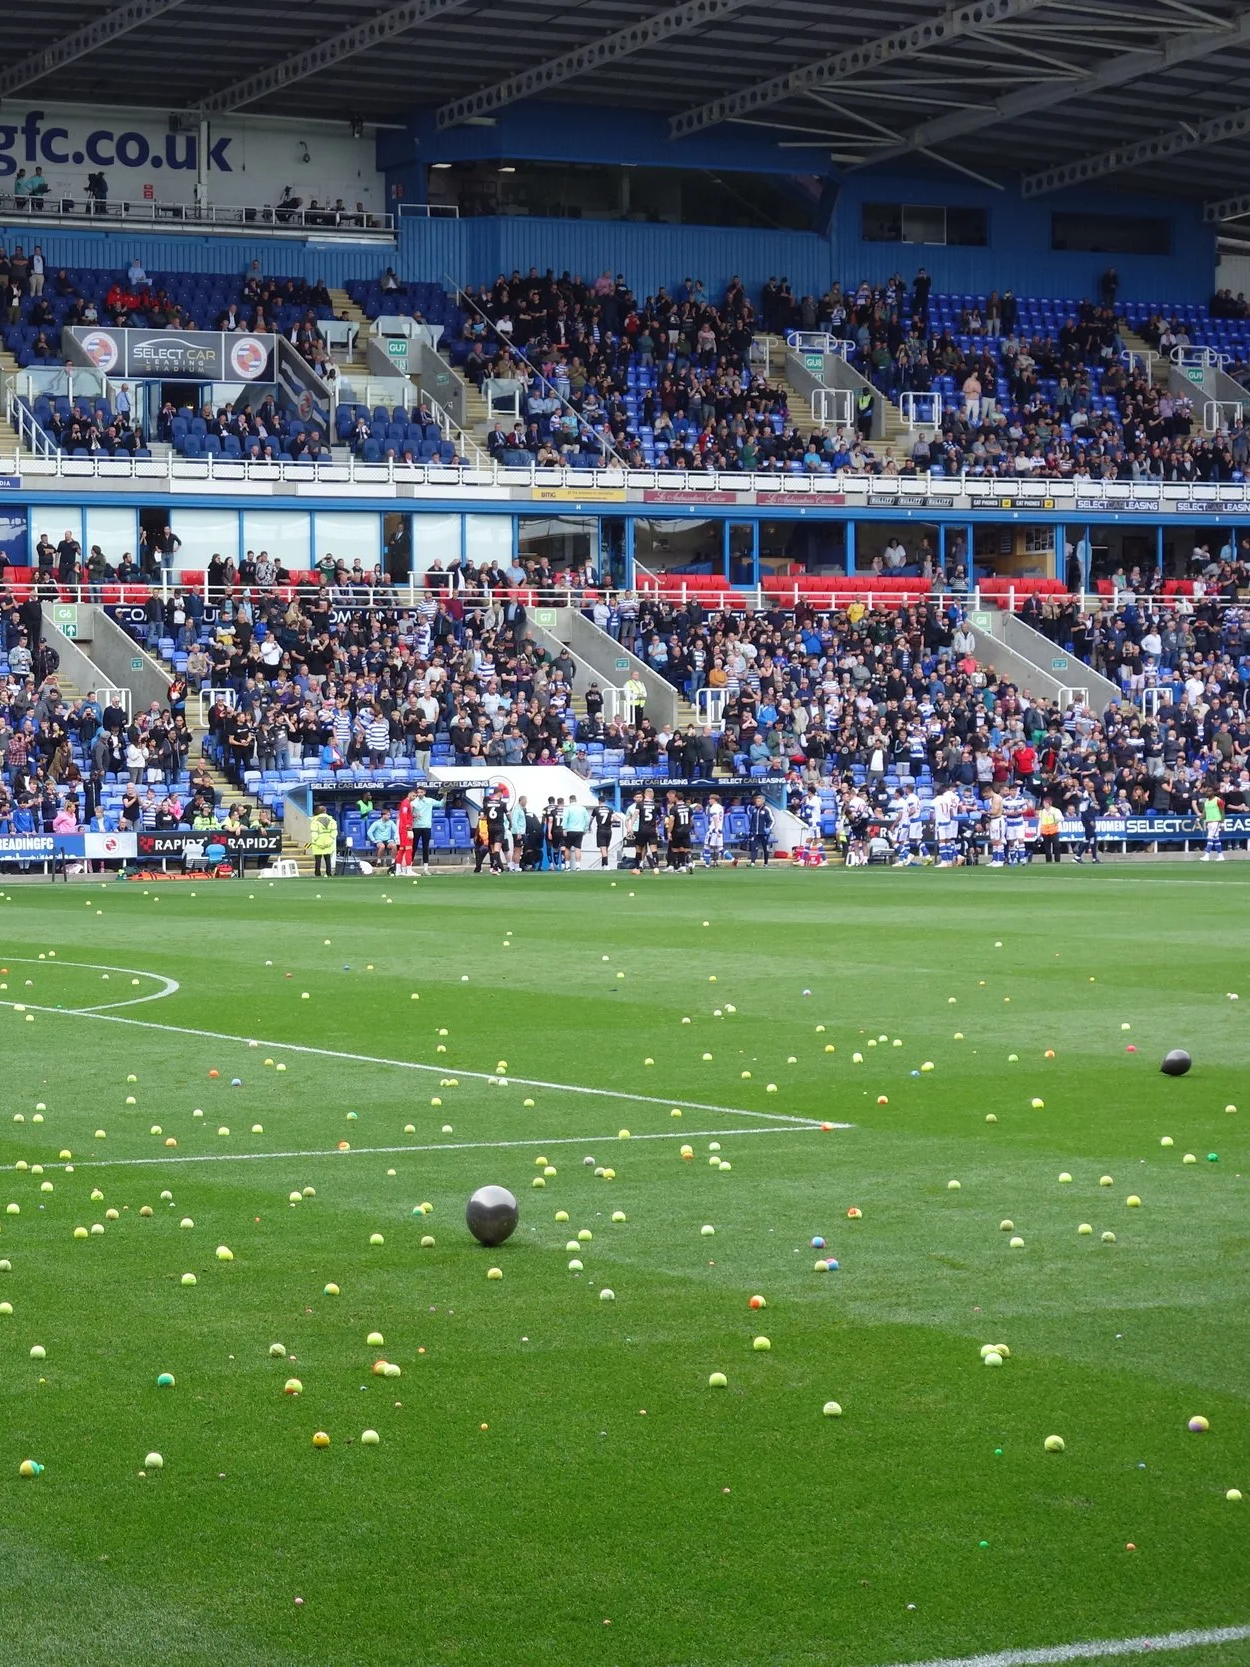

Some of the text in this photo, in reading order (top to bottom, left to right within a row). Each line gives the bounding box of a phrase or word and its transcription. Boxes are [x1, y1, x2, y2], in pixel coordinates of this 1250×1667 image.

[389, 343, 406, 352] GU7
[133, 349, 216, 361] SELECT CAR
[806, 359, 823, 367] GU8
[145, 365, 205, 373] STADIUM
[58, 609, 72, 619] G6
[540, 613, 551, 622] G7
[975, 615, 988, 625] G8
[489, 807, 497, 819] 6
[600, 812, 608, 824] 7
[644, 808, 653, 821] 5
[679, 812, 690, 825] 11
[228, 837, 277, 849] RAPIDZ
